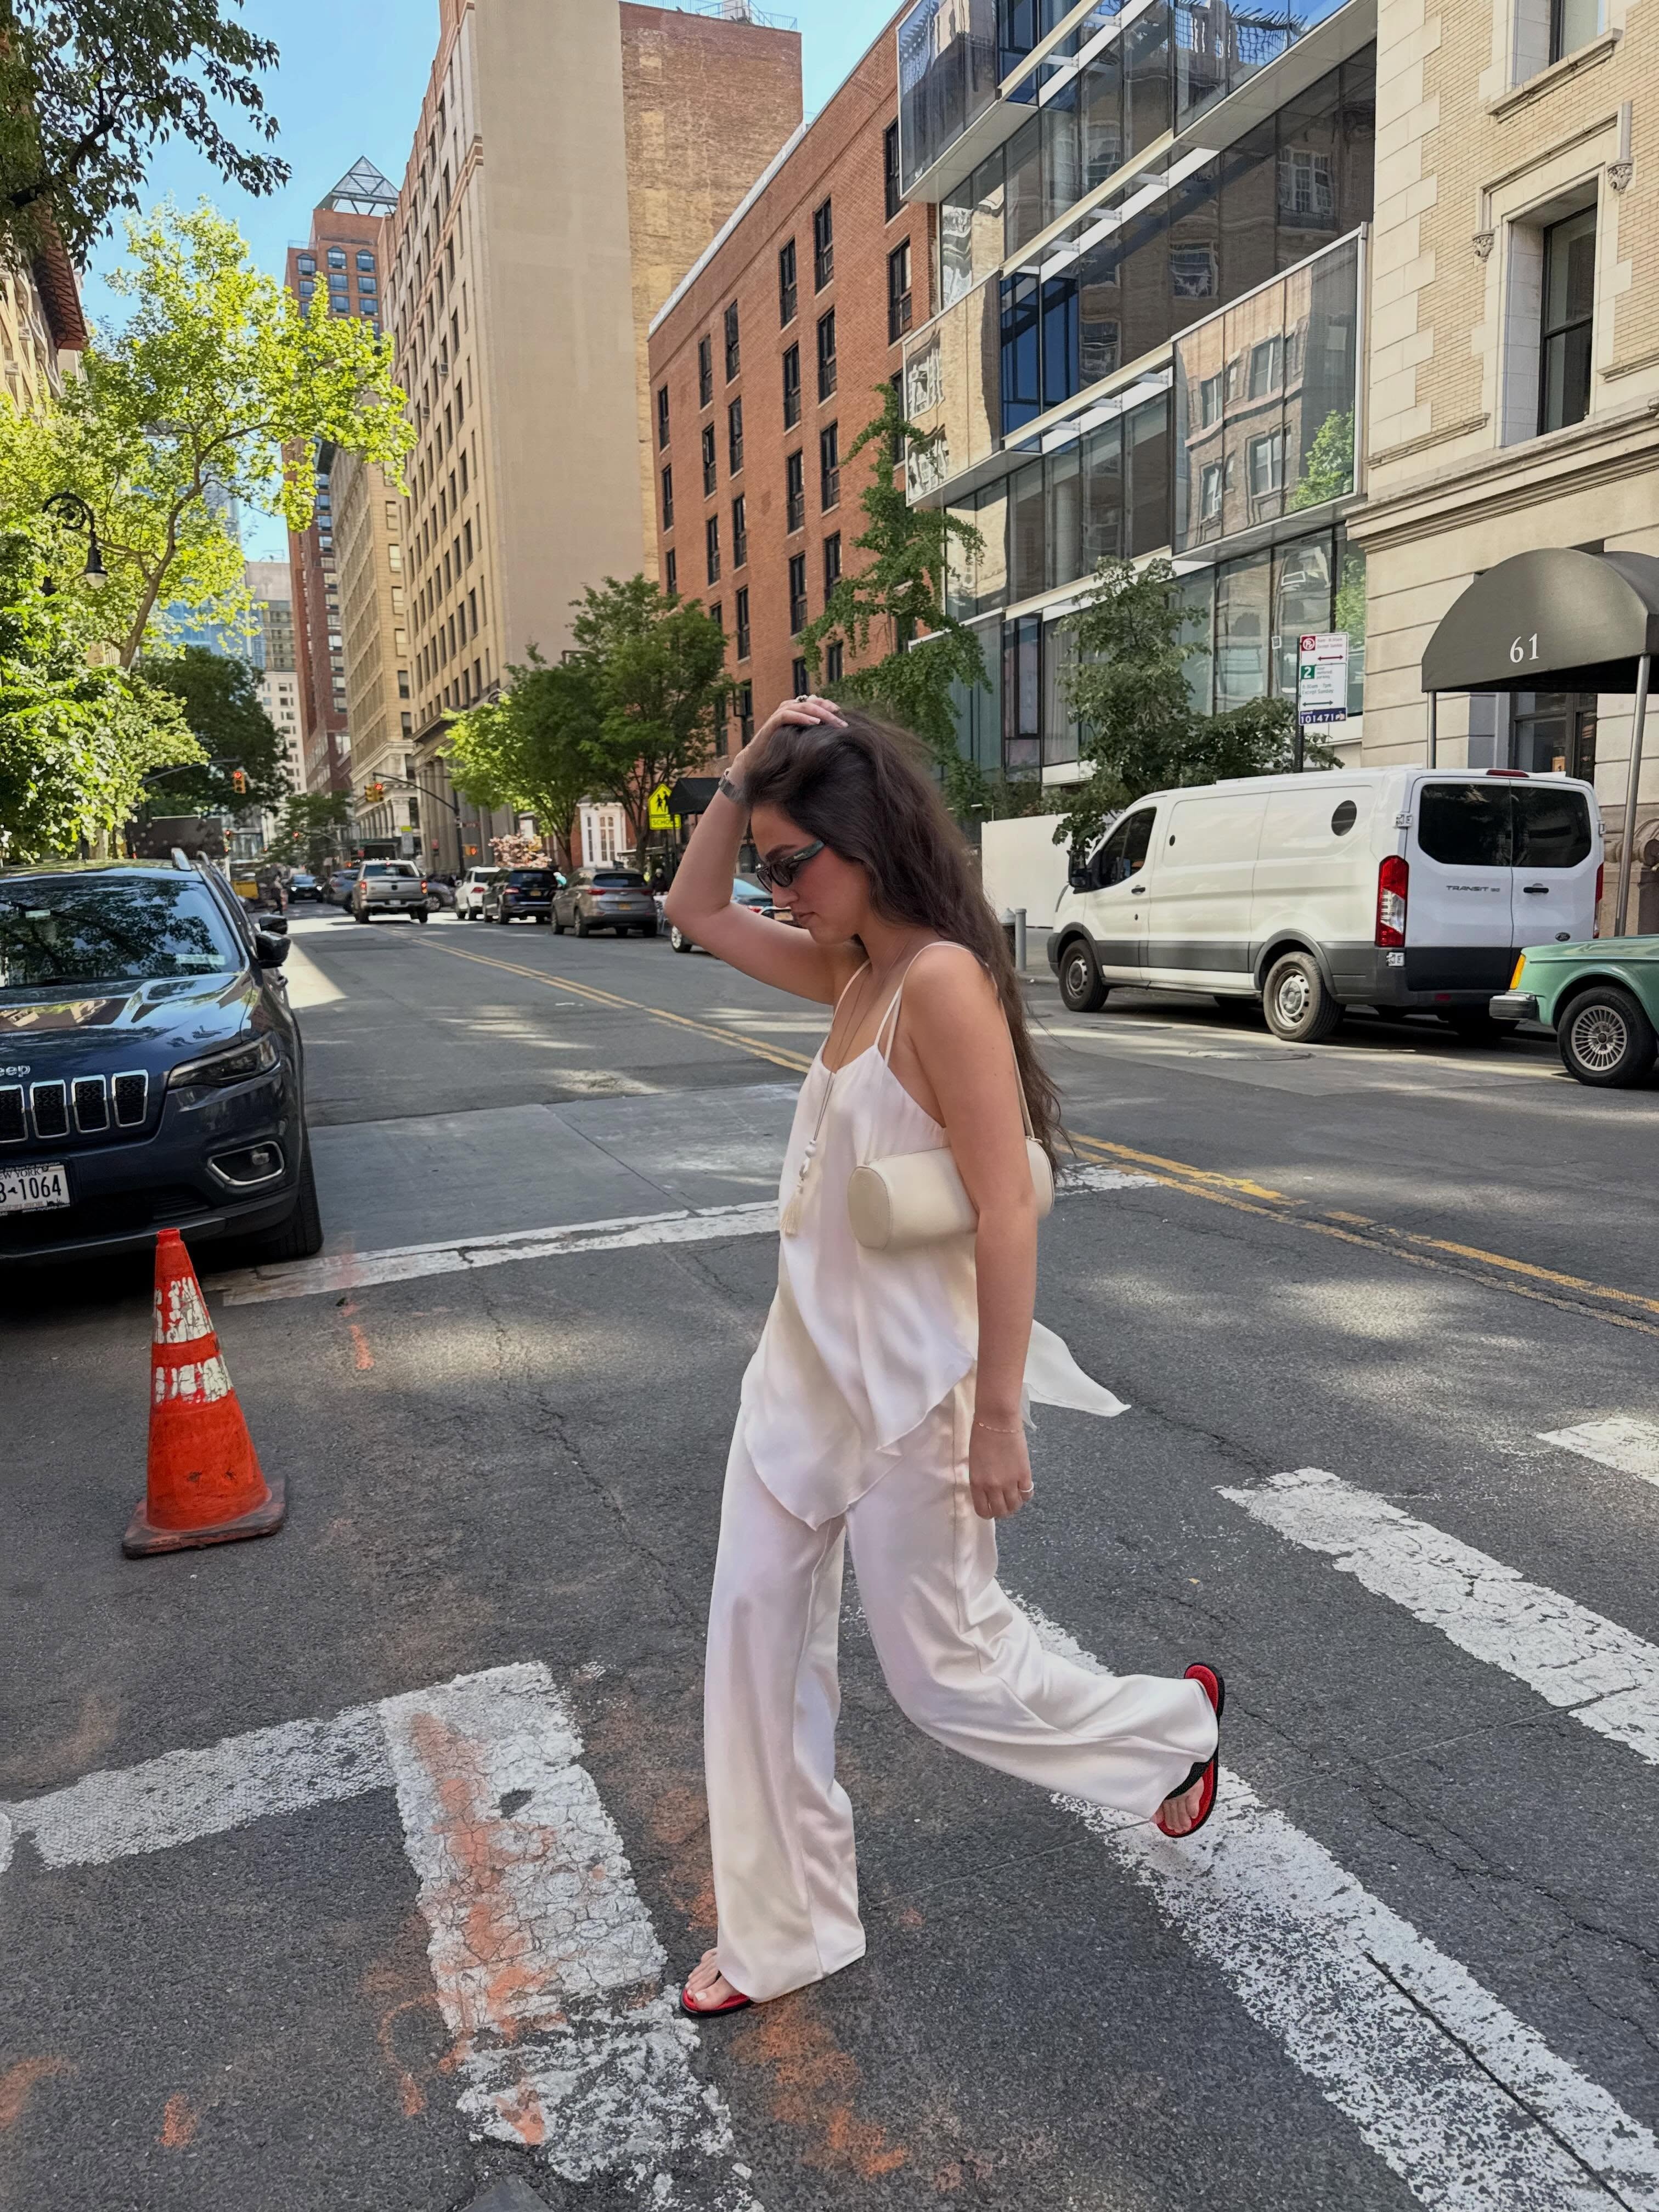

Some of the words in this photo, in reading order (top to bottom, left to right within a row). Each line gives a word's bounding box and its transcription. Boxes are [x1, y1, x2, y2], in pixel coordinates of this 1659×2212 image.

[1510, 633, 1539, 663] 61
[1304, 666, 1312, 679] 2
[15, 1167, 41, 1178] YORK
